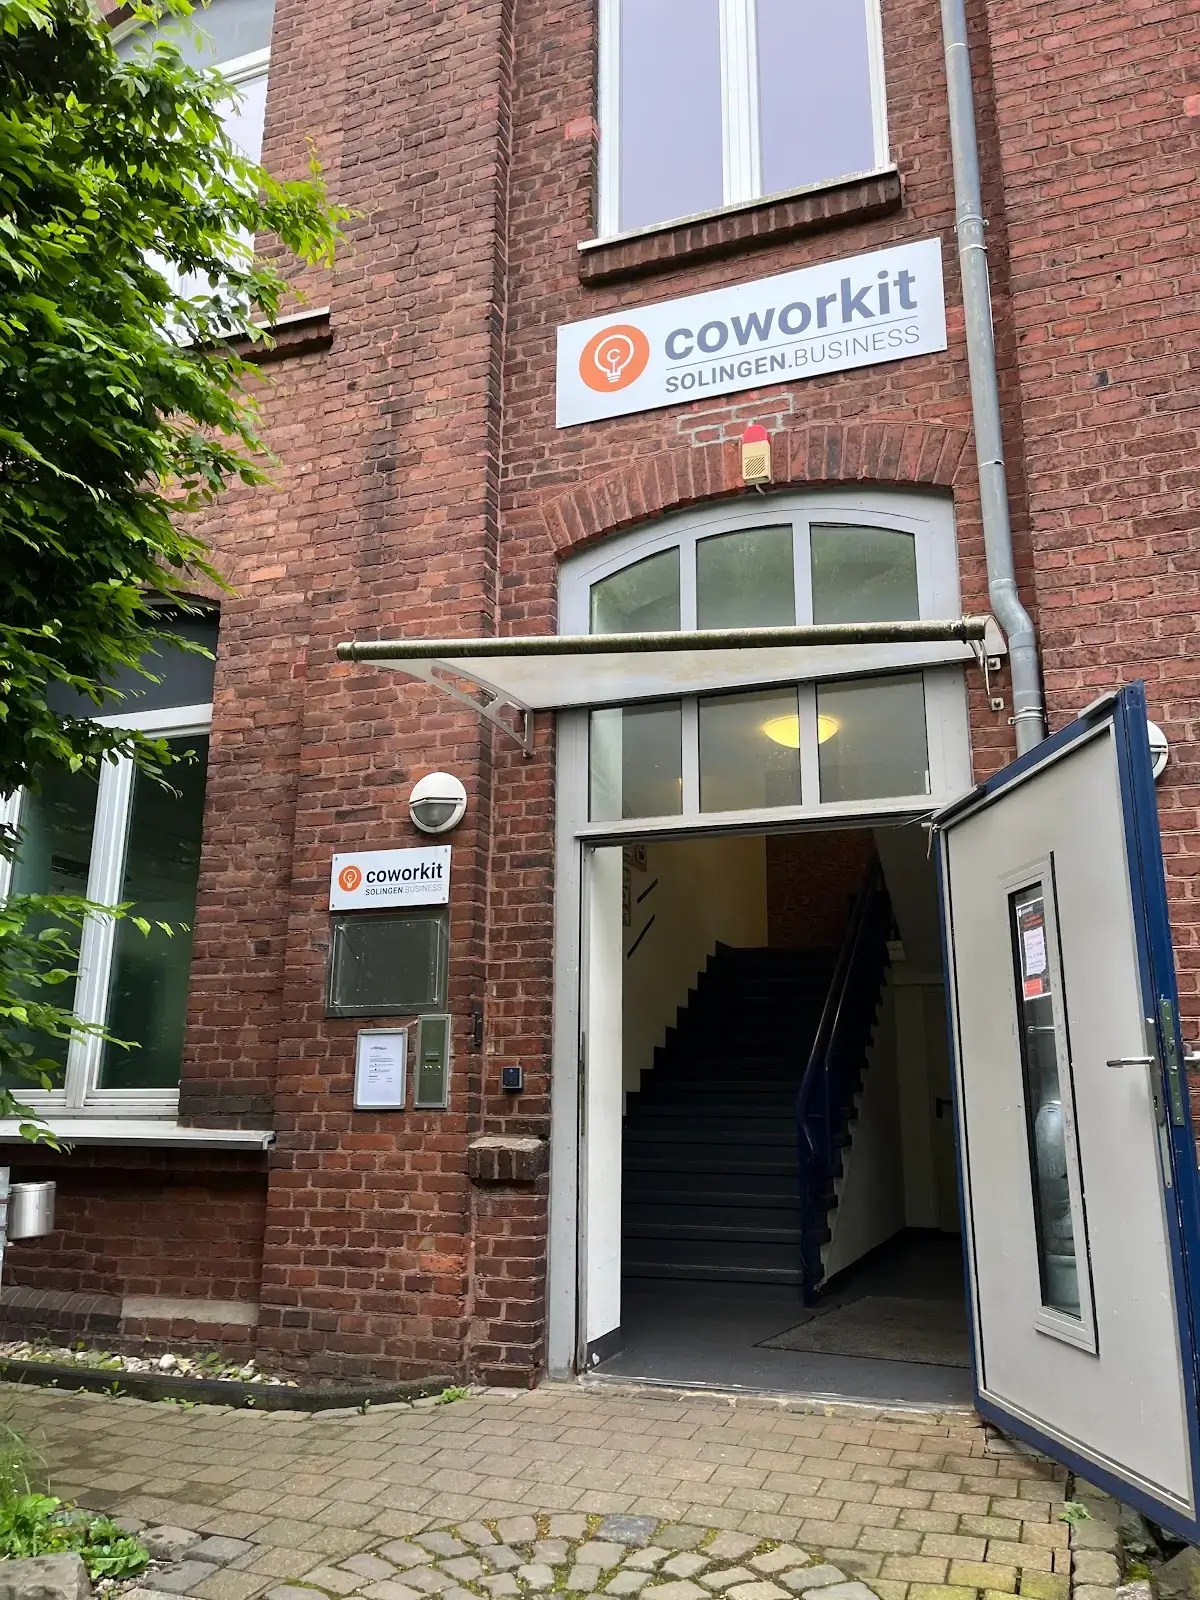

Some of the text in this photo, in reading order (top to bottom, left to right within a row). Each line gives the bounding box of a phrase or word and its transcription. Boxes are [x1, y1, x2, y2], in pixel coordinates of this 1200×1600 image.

[664, 269, 917, 361] coworkit
[665, 324, 920, 393] SOLINGEN.BUSINESS
[365, 883, 443, 896] SOLINGEN.BUSINESS
[366, 862, 443, 883] coworkit
